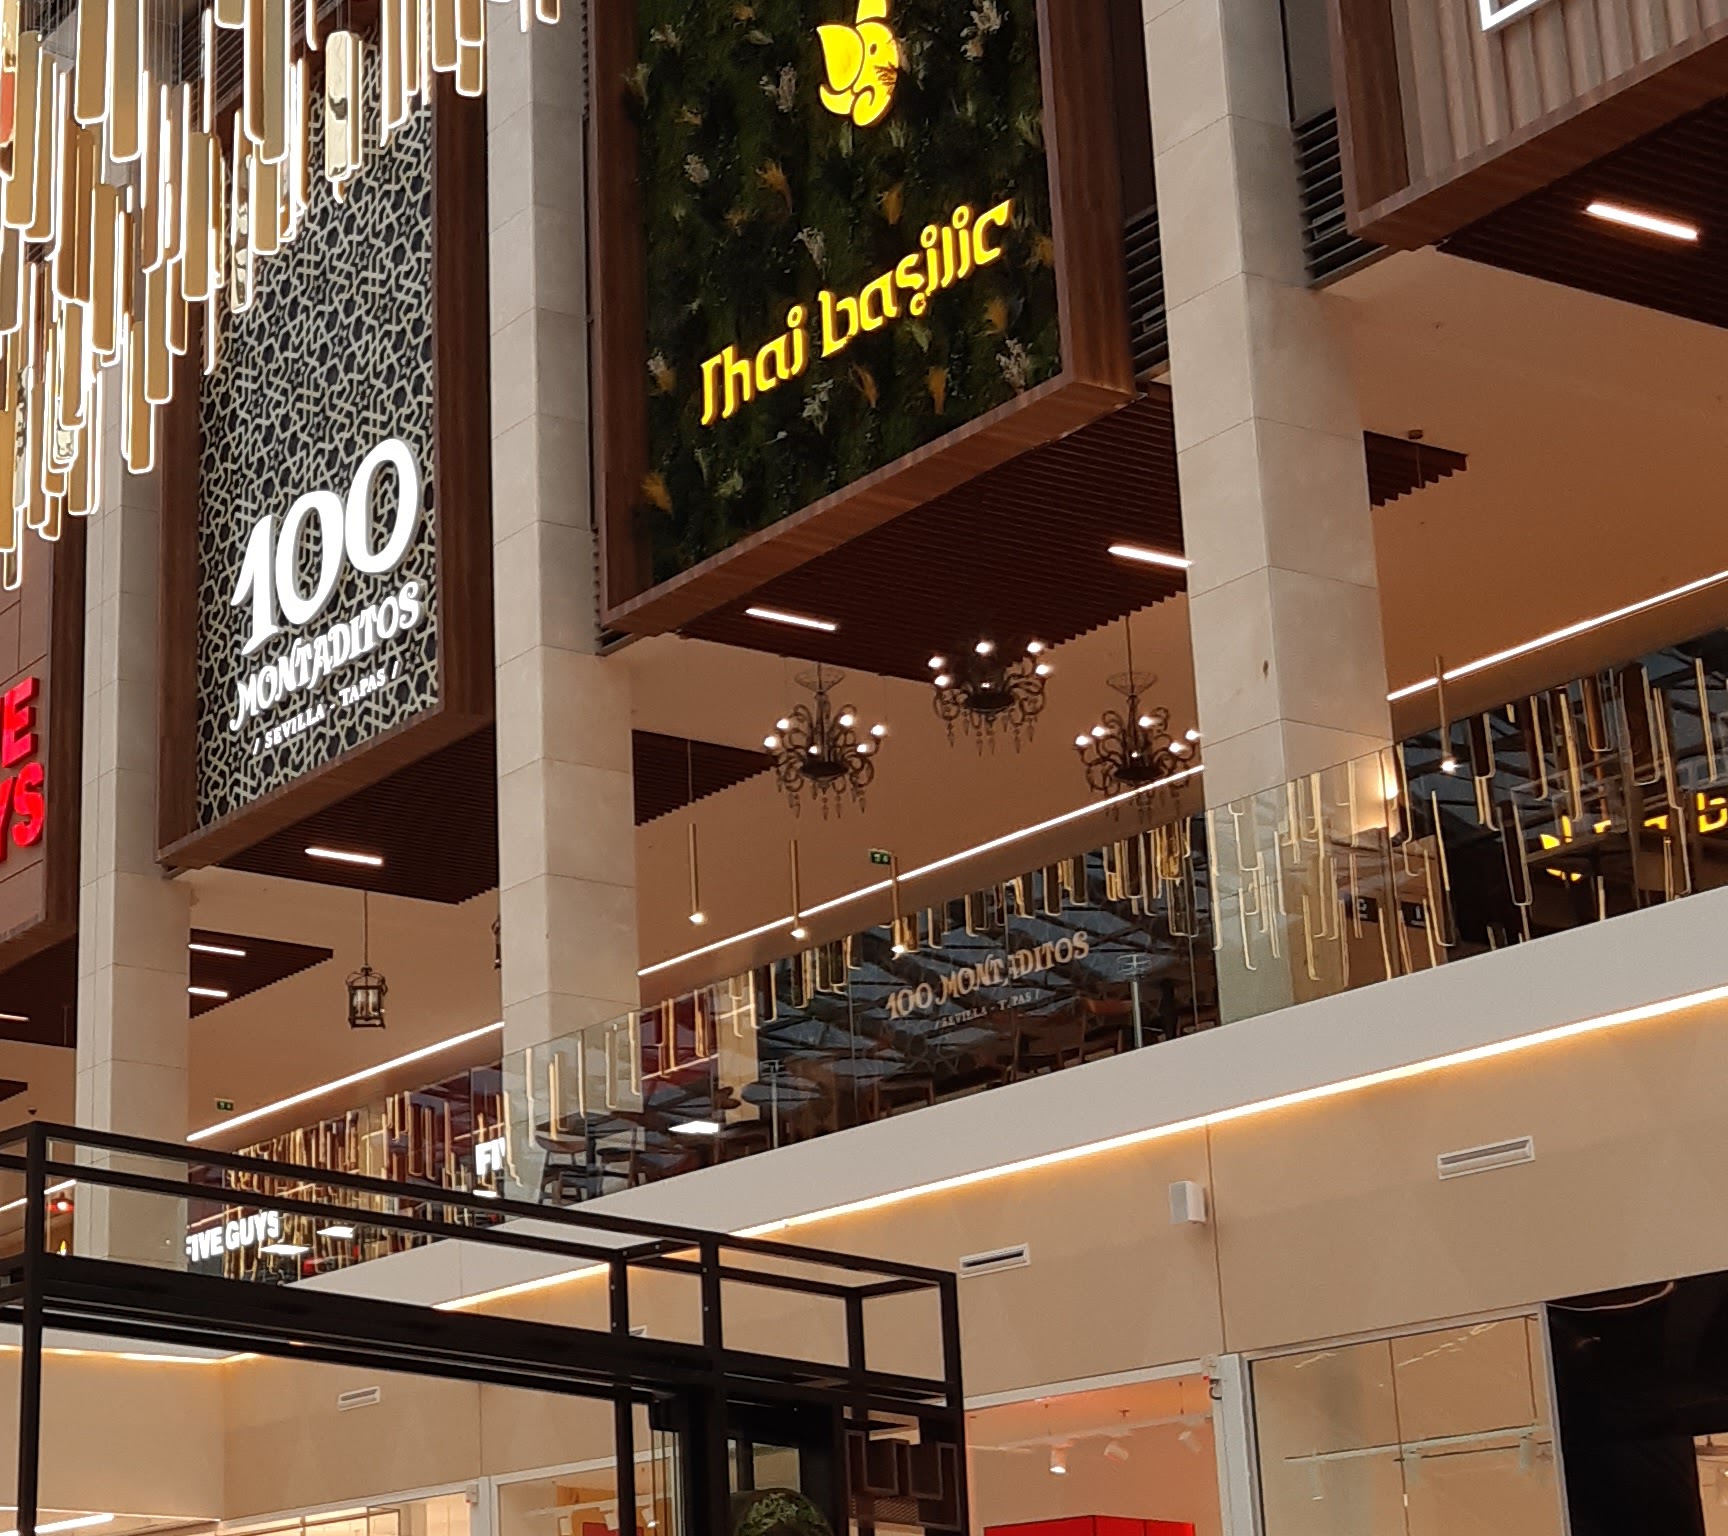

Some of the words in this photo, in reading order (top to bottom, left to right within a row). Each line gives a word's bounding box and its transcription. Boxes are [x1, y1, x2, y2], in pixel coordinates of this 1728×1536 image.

[701, 305, 808, 425] Thai
[229, 438, 420, 656] 100
[229, 581, 421, 732] MONTADITOS
[264, 704, 325, 750] SEVILLA
[339, 668, 386, 707] TAPAS
[885, 982, 934, 1020] 100
[225, 1210, 279, 1251] GUYS
